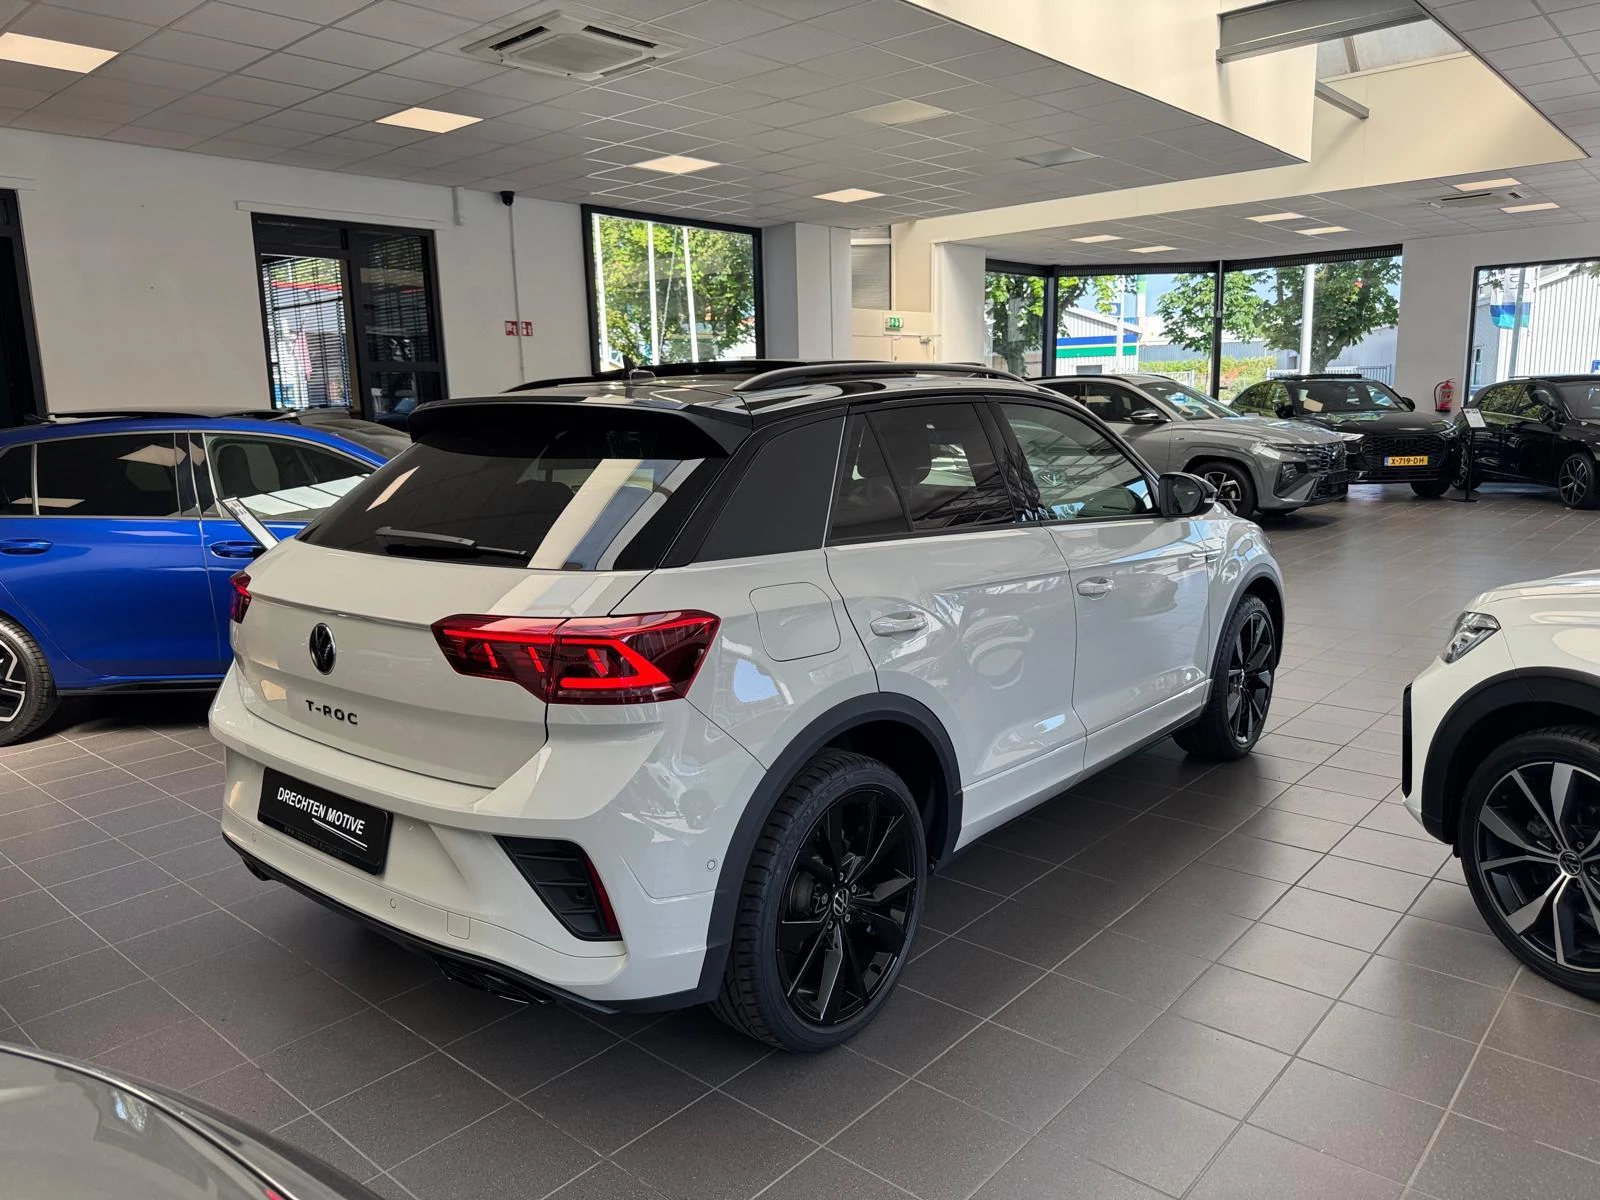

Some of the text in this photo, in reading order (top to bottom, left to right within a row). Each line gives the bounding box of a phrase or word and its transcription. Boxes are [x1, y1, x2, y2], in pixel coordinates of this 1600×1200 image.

[1391, 457, 1425, 465] X-719-DH
[305, 699, 358, 725] T-ROC
[277, 787, 366, 835] DRECHTEN MOTIVE
